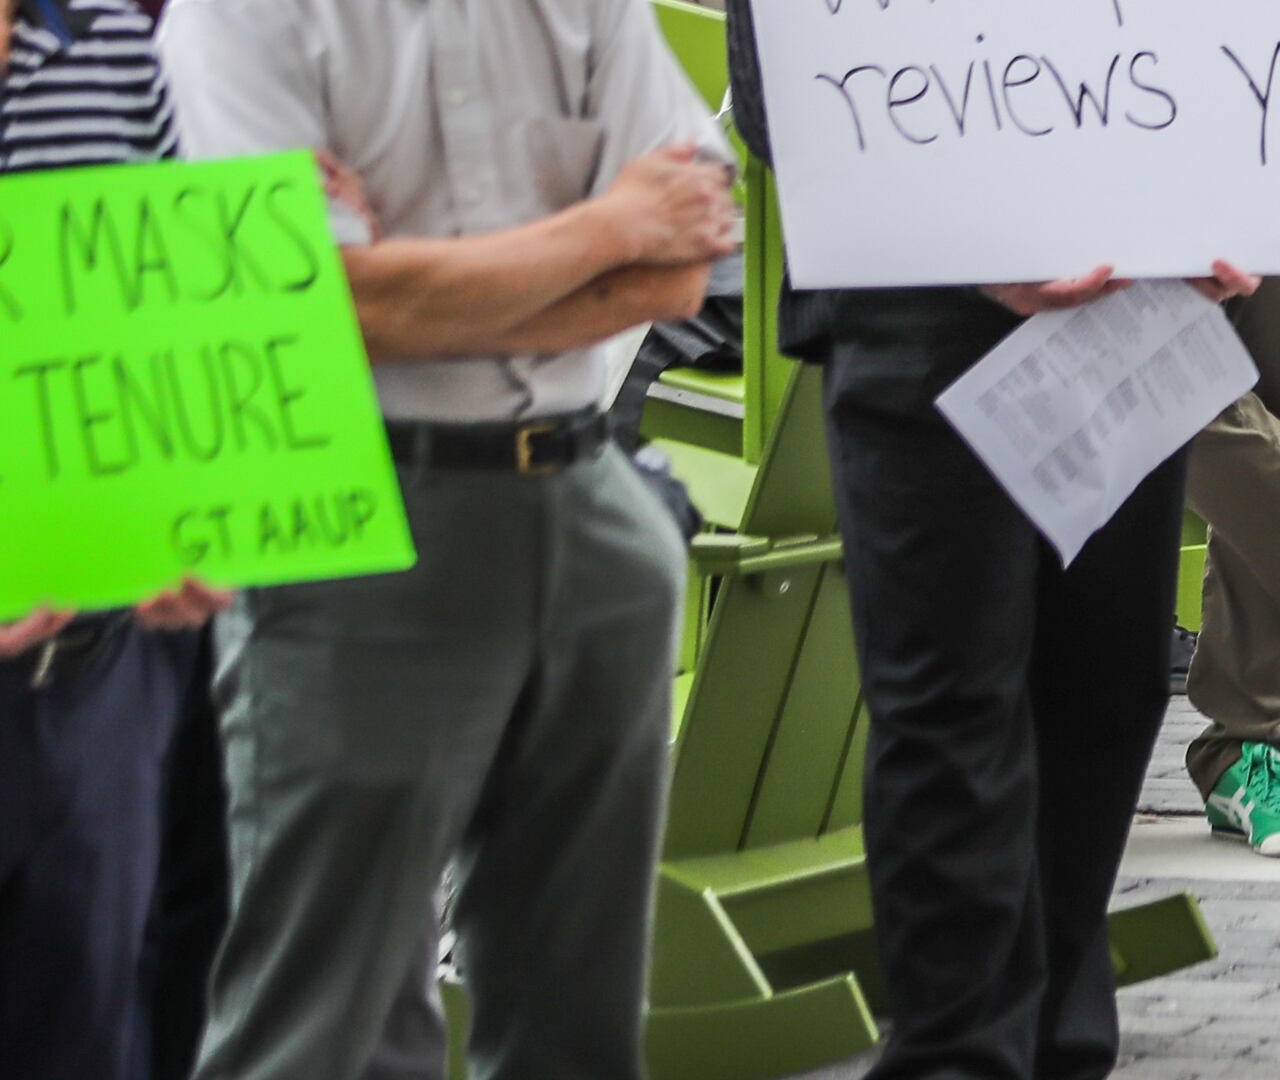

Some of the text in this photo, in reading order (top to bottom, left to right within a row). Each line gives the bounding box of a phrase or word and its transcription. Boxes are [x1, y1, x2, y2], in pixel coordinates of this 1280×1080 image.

[814, 33, 1178, 153] reviews
[58, 180, 320, 317] MASKS
[13, 332, 333, 482] TENURE
[171, 486, 379, 565] GT AAUP
